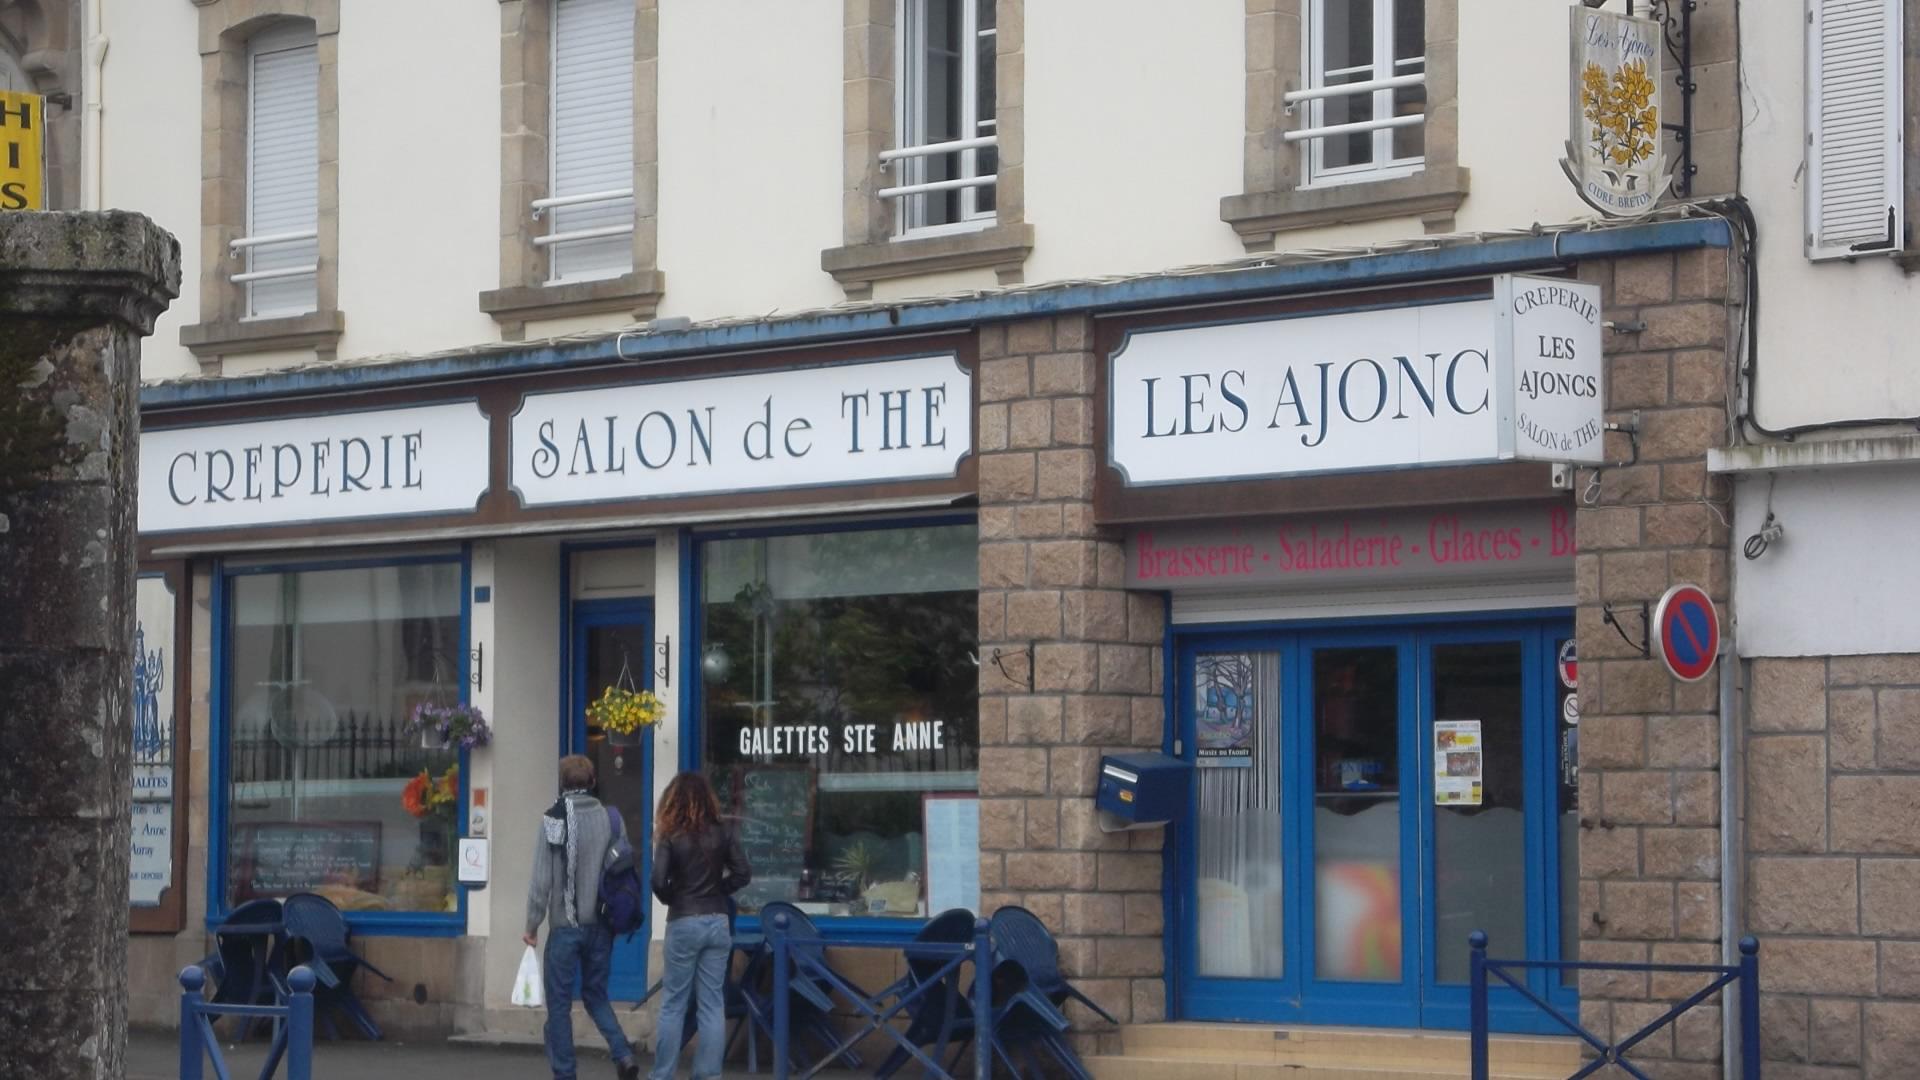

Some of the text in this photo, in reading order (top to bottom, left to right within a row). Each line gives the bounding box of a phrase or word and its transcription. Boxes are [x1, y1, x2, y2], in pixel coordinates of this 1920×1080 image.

[1586, 14, 1609, 48] Les
[1588, 182, 1652, 209] CIDRE BRETON
[1514, 286, 1598, 325] CREPERIE
[1538, 335, 1576, 360] LES
[1141, 369, 1249, 438] LES
[1519, 369, 1597, 400] AJONCS
[531, 382, 947, 479] SALON de THE
[1517, 412, 1600, 452] SALON de THE
[168, 429, 422, 506] CREPERIE
[1137, 528, 1254, 580] Brasserie
[1280, 517, 1403, 572] Saladerie
[1428, 512, 1522, 566] Glaces
[739, 720, 944, 756] GALETTES STE ANNE
